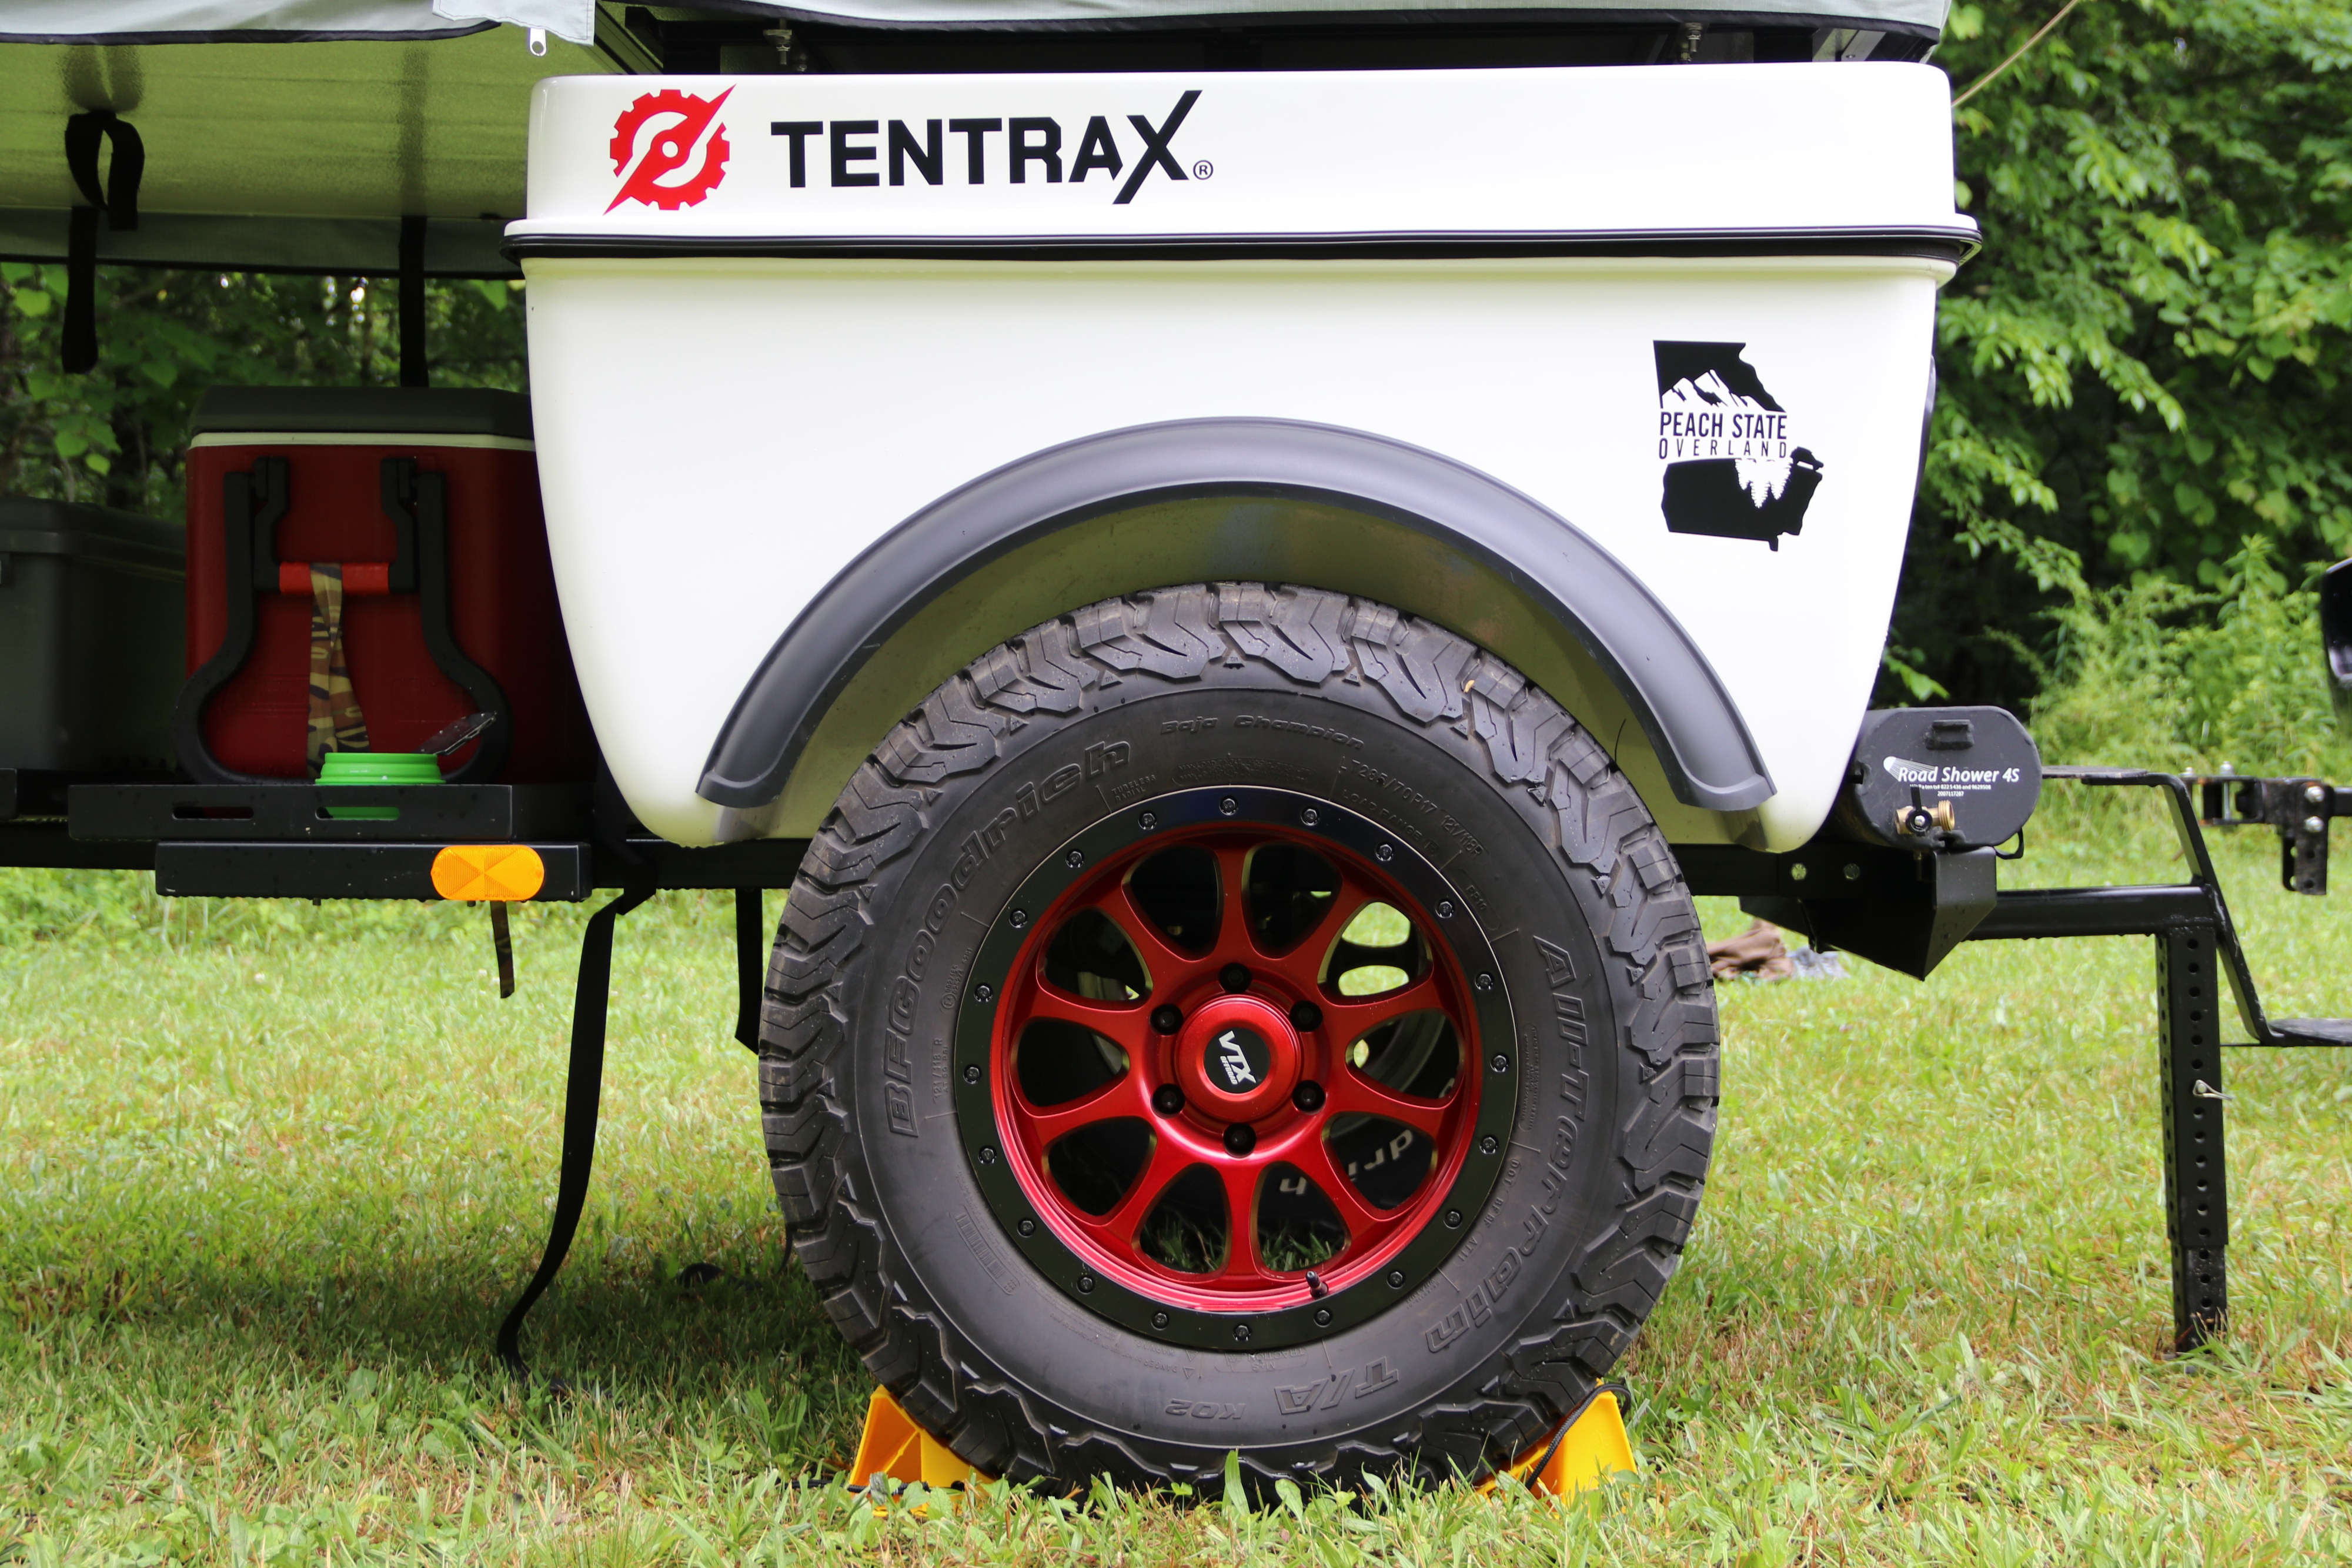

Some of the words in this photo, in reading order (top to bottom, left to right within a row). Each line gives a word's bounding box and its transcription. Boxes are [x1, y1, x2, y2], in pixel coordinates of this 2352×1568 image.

[1659, 412, 1723, 437] PEACH
[1732, 413, 1788, 439] STATE
[1659, 438, 1787, 459] OVERLAND
[1161, 716, 1218, 735] Baja
[1234, 714, 1365, 750] Champion
[1897, 766, 1938, 783] Road
[1941, 766, 2000, 783] Shower
[2002, 767, 2020, 783] 4S
[883, 741, 1130, 1137] BFGoodrich
[1219, 1030, 1256, 1083] VTX
[1220, 1055, 1238, 1085] OFFROAD
[1502, 1159, 1521, 1186] DOT
[1274, 1356, 1399, 1415] T/A
